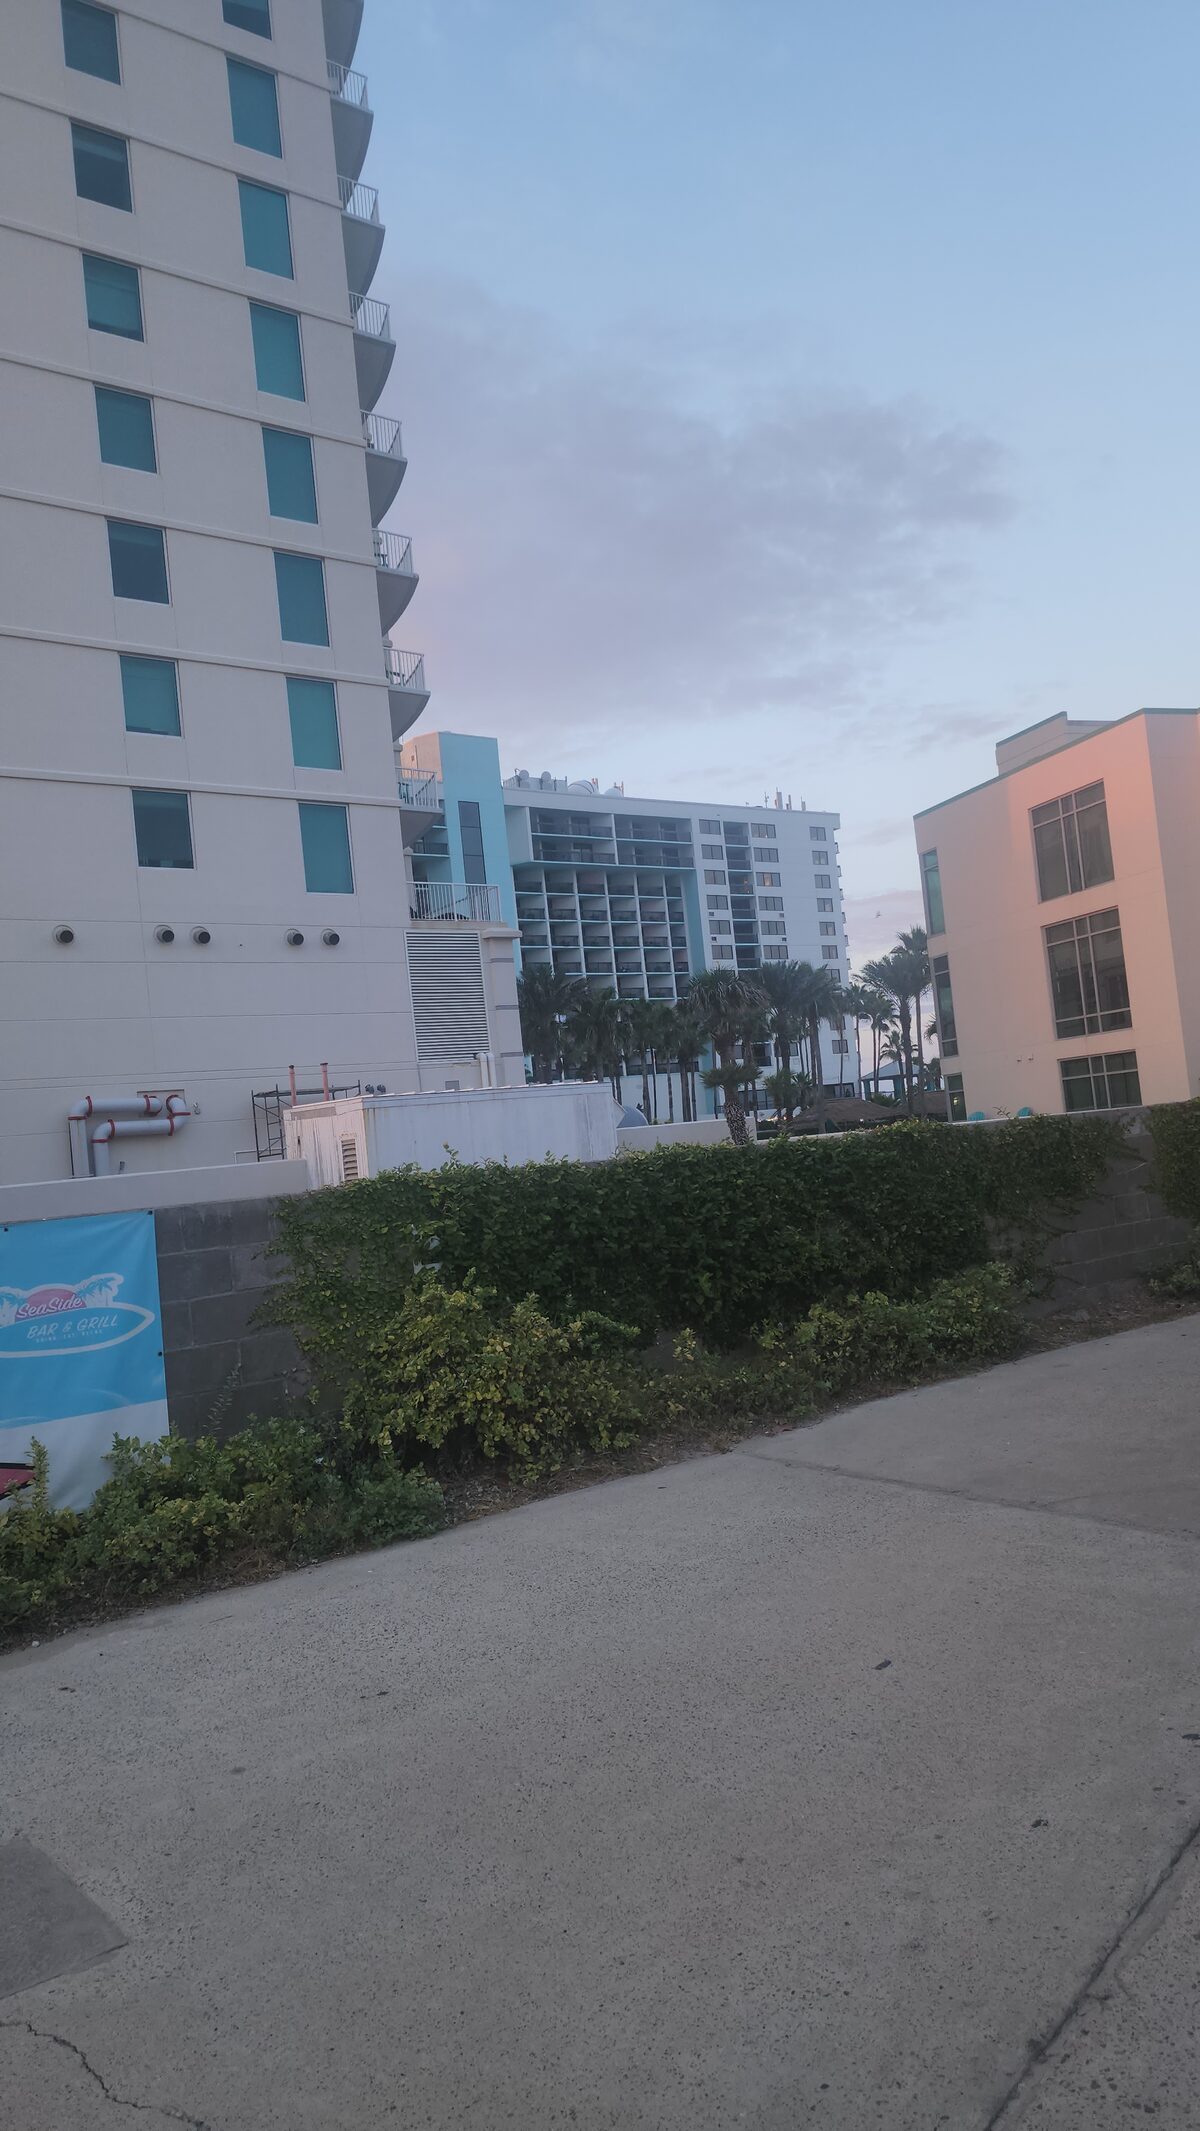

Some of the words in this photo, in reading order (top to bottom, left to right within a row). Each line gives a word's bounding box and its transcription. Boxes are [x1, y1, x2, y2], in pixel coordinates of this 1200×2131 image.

[16, 1294, 83, 1319] SeaSide
[26, 1322, 59, 1340] BAR
[62, 1321, 73, 1333] &
[76, 1314, 118, 1331] GRILL
